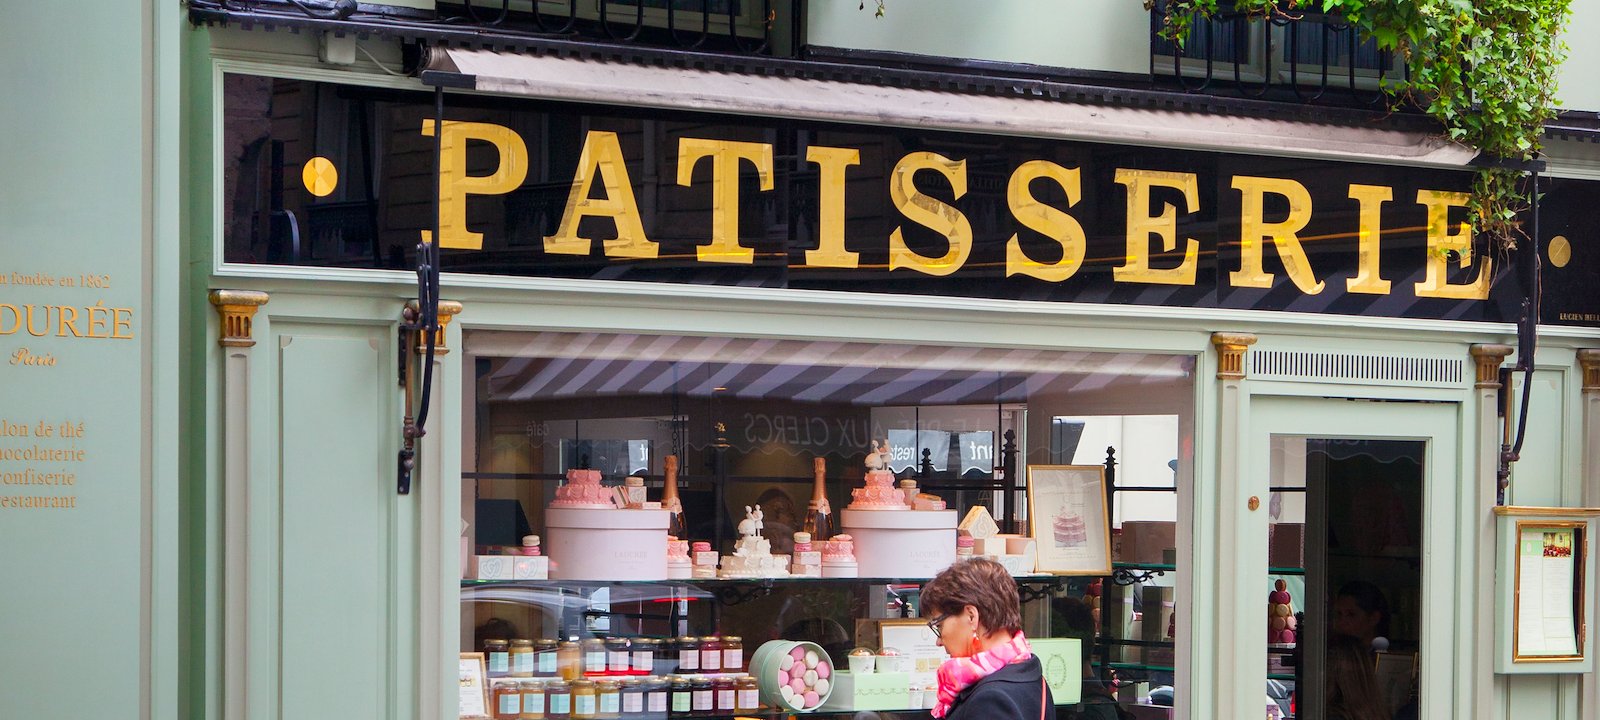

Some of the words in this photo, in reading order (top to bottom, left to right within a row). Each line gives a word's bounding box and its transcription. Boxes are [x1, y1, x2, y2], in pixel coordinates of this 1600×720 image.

[420, 119, 1492, 300] PATISSERIE
[11, 271, 55, 286] fondée
[59, 276, 75, 287] en
[79, 274, 111, 288] 1862
[9, 347, 57, 367] Paris
[34, 420, 54, 438] de
[59, 420, 85, 438] thé
